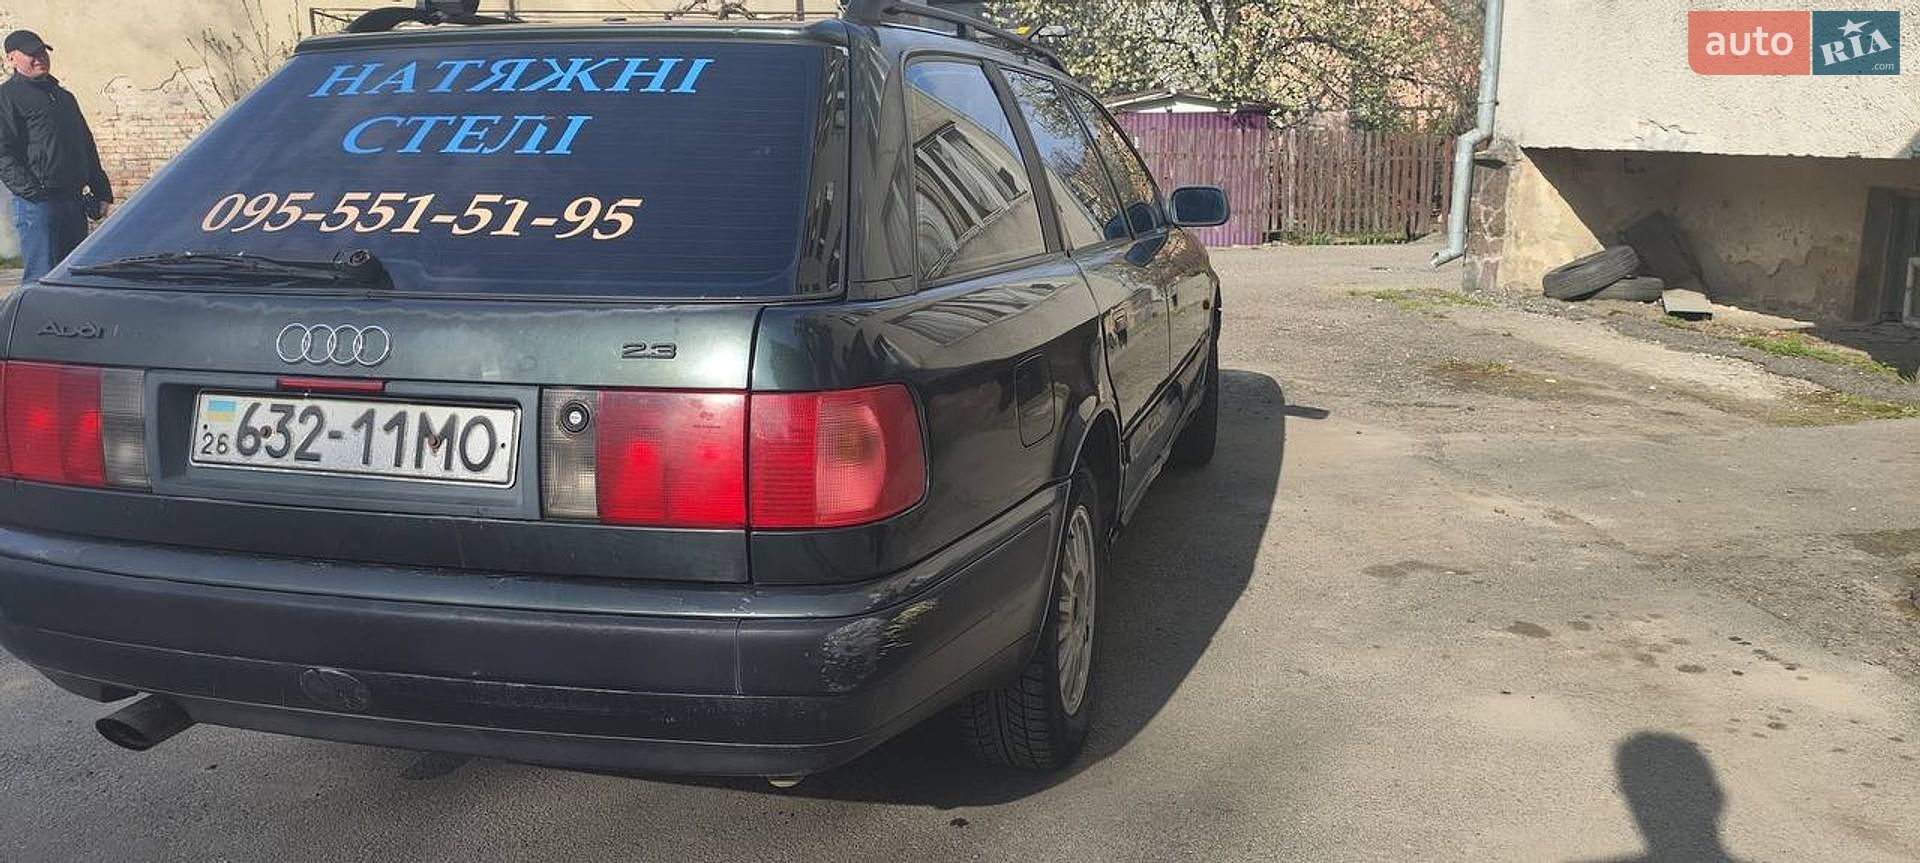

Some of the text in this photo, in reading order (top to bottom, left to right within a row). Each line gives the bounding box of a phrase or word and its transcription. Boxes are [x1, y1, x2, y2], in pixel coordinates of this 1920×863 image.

[308, 57, 714, 98] НАТЯЖНІ
[341, 114, 593, 155] СТЕЛІ
[201, 191, 644, 241] 095-551-51-95
[201, 433, 228, 455] 26
